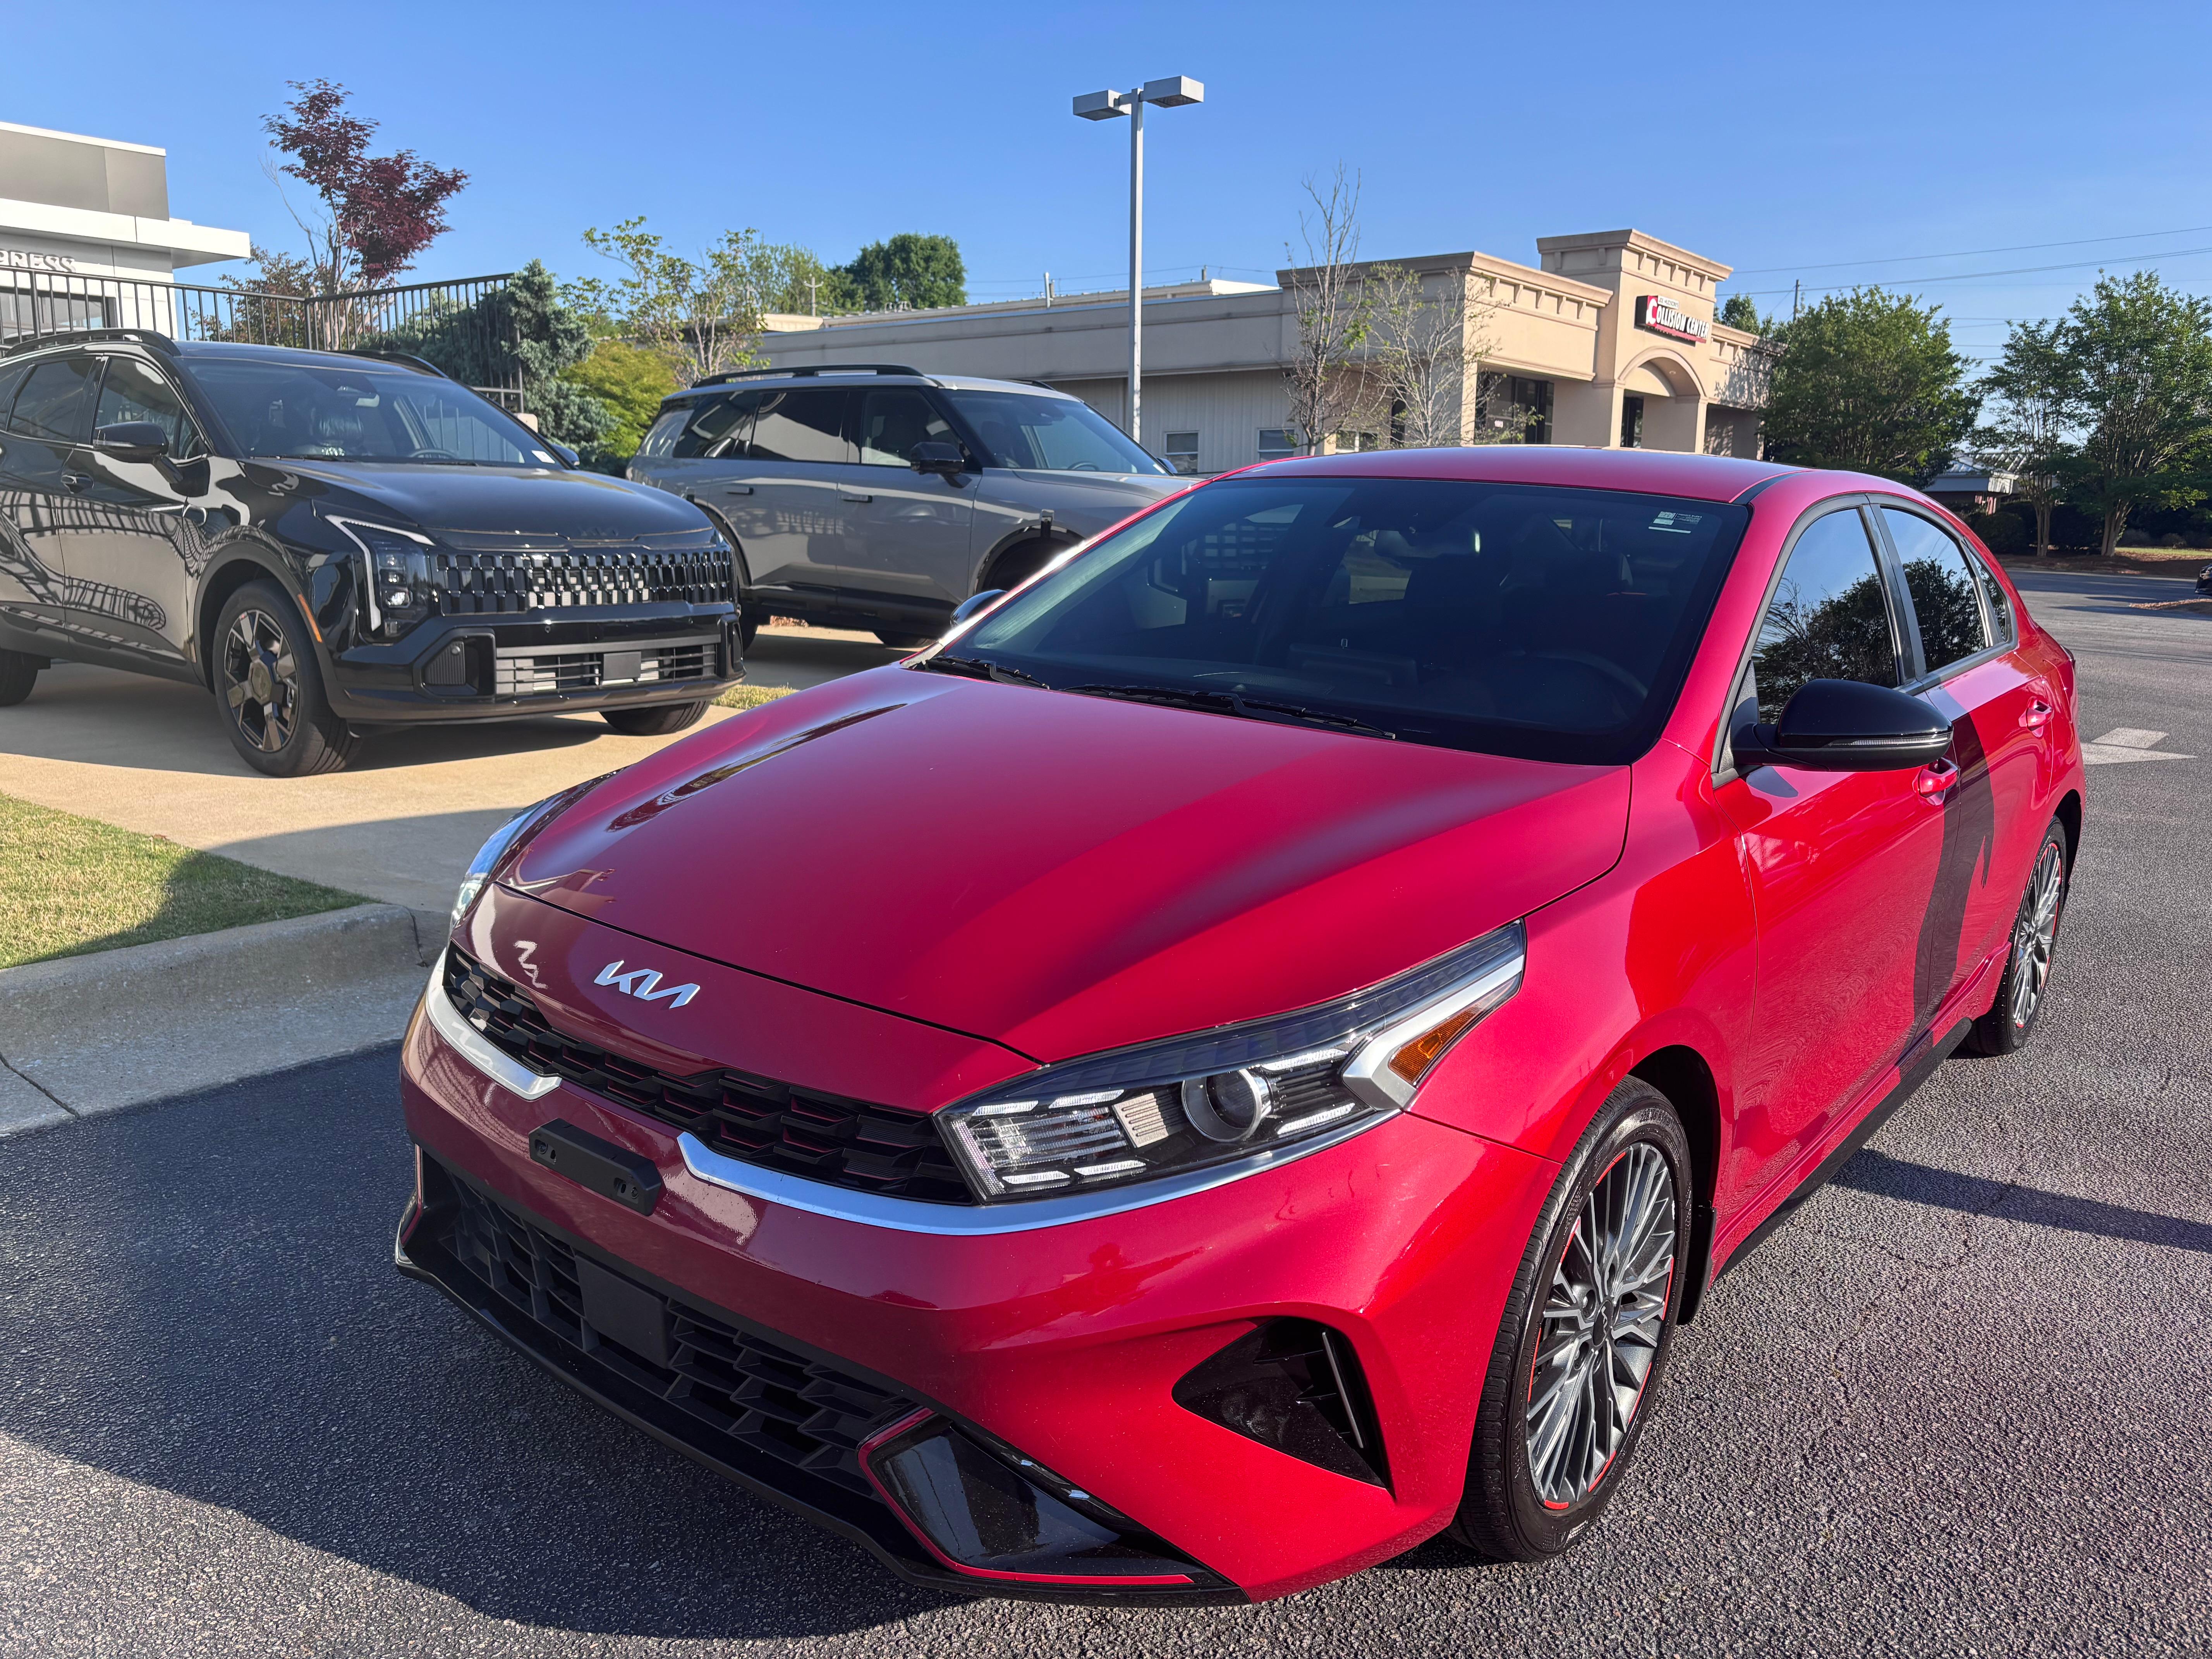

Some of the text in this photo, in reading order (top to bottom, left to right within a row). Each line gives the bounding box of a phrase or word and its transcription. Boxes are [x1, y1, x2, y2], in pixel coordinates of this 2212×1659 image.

[1646, 298, 1710, 338] COLLISION CENTER
[594, 960, 700, 1009] KIA
